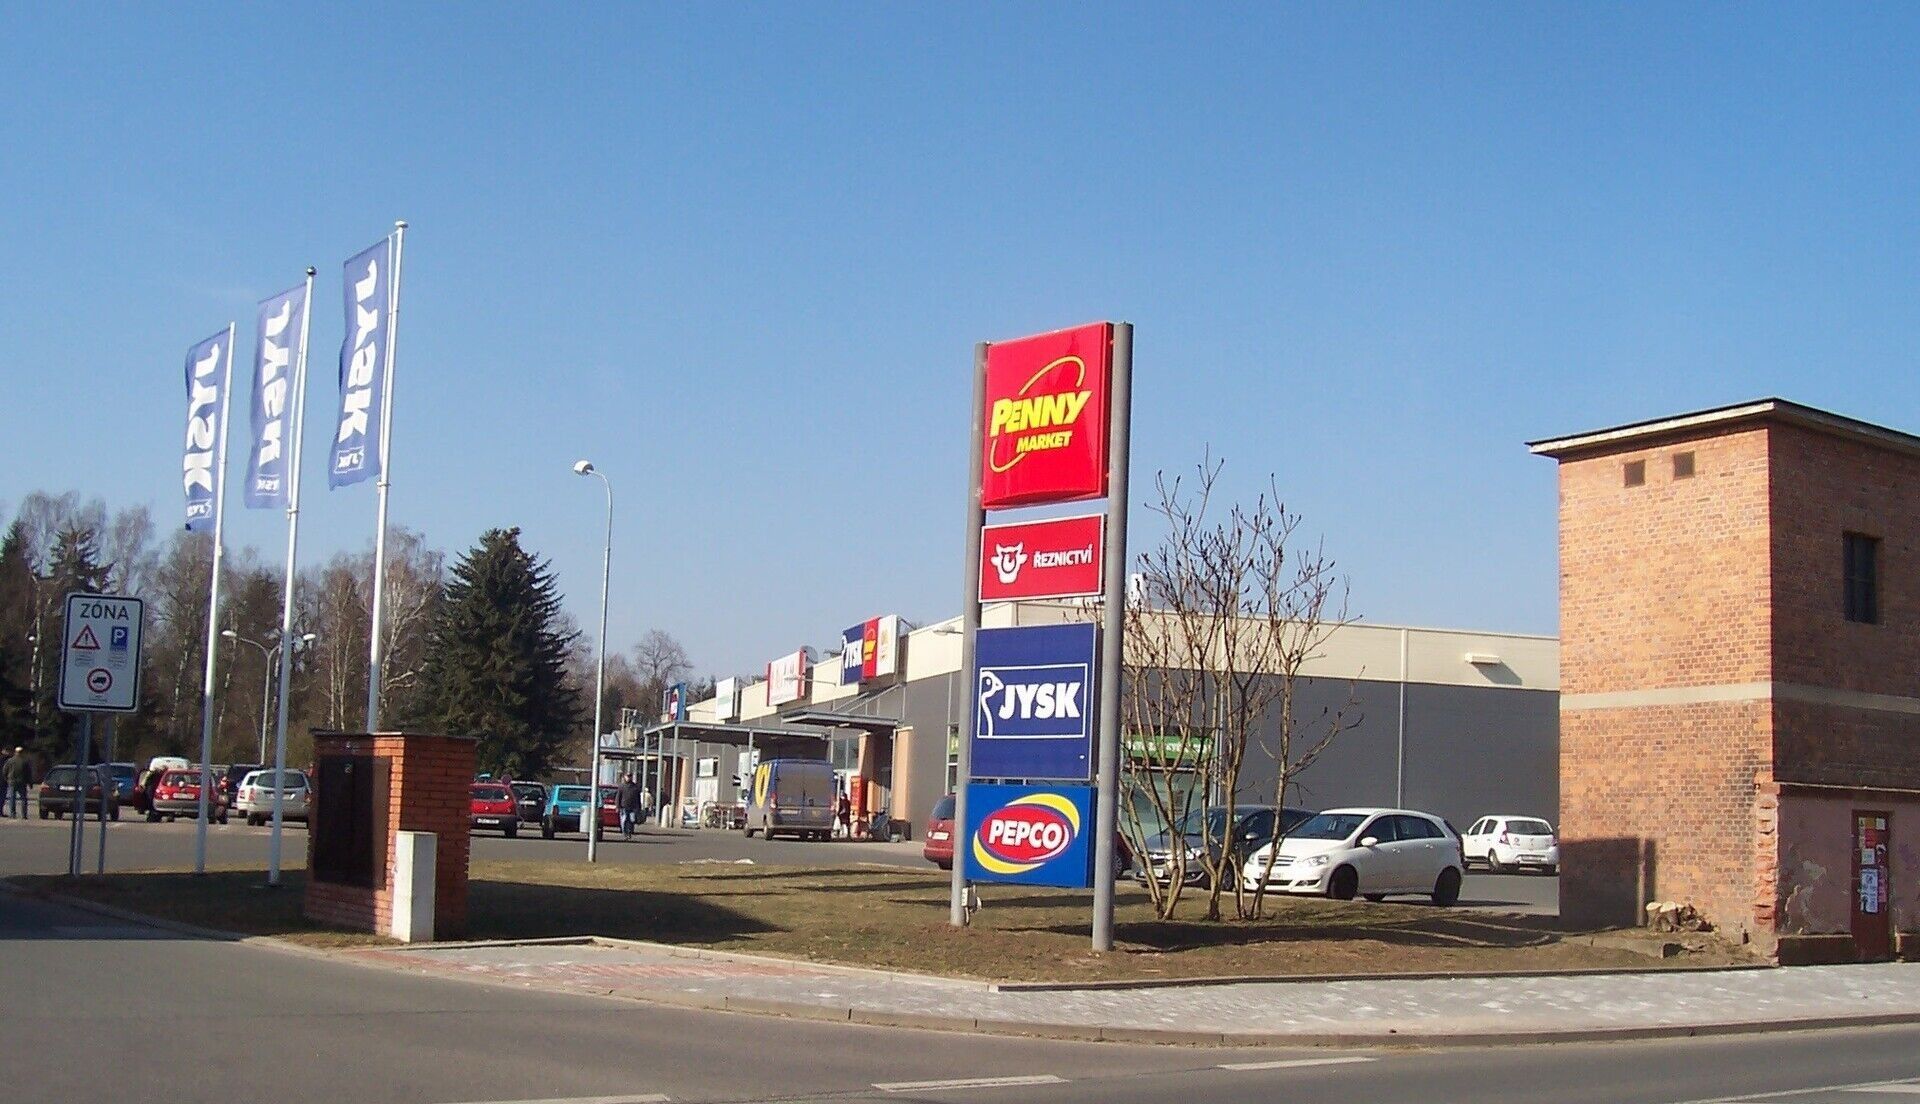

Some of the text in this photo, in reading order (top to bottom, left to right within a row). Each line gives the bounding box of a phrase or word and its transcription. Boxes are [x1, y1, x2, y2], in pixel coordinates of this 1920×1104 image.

[989, 390, 1093, 438] PENNY
[1016, 430, 1073, 454] MARKET
[1032, 543, 1094, 569] ŘEZNICTVÍ
[80, 600, 130, 620] ZÓNA
[113, 629, 126, 644] P
[998, 681, 1081, 719] JYSK
[988, 818, 1064, 850] PEPCO
